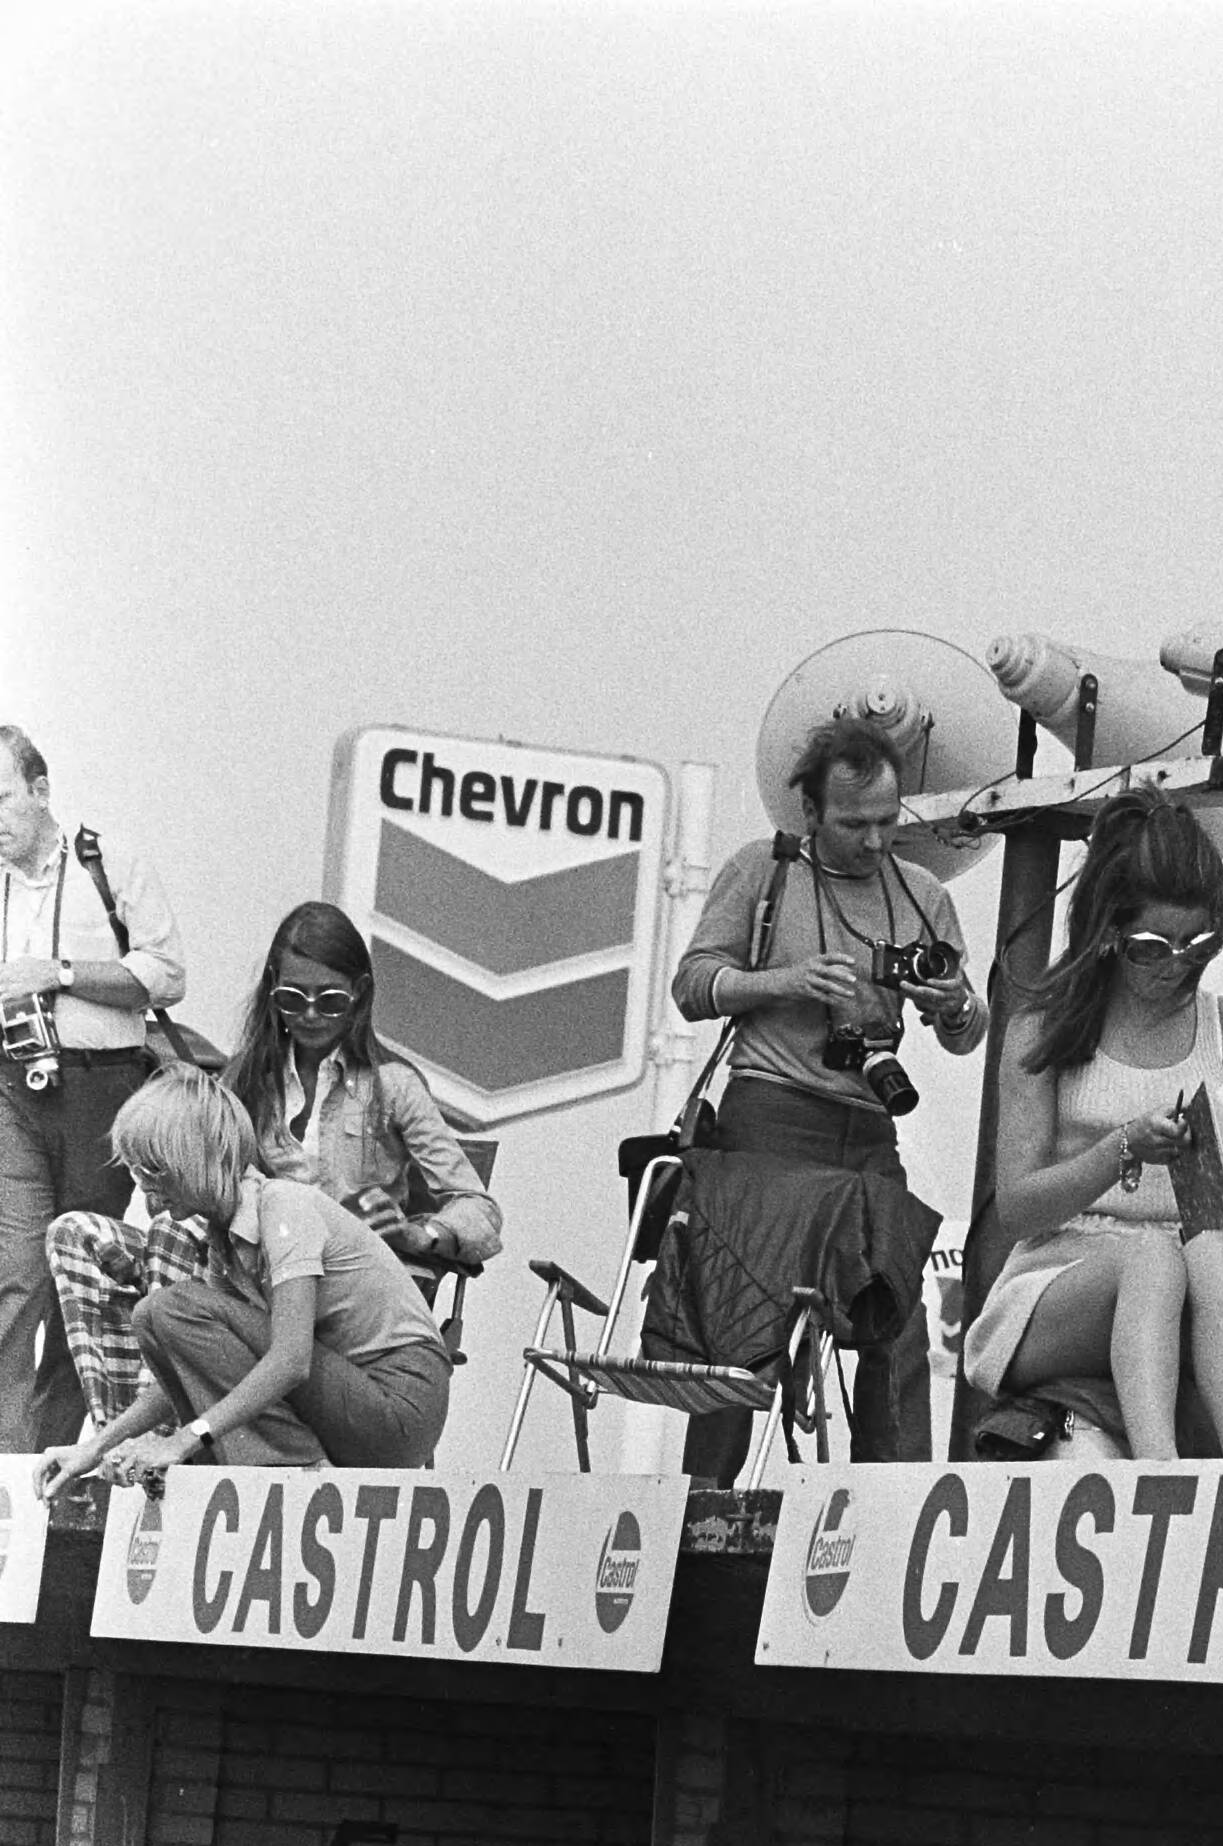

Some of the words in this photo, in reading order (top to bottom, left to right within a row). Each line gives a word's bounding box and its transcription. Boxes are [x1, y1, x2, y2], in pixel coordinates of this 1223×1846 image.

[380, 748, 644, 842] Chevron
[192, 1478, 546, 1653] CASTROL
[600, 1555, 640, 1589] Castrol
[810, 1534, 857, 1570] Castrol
